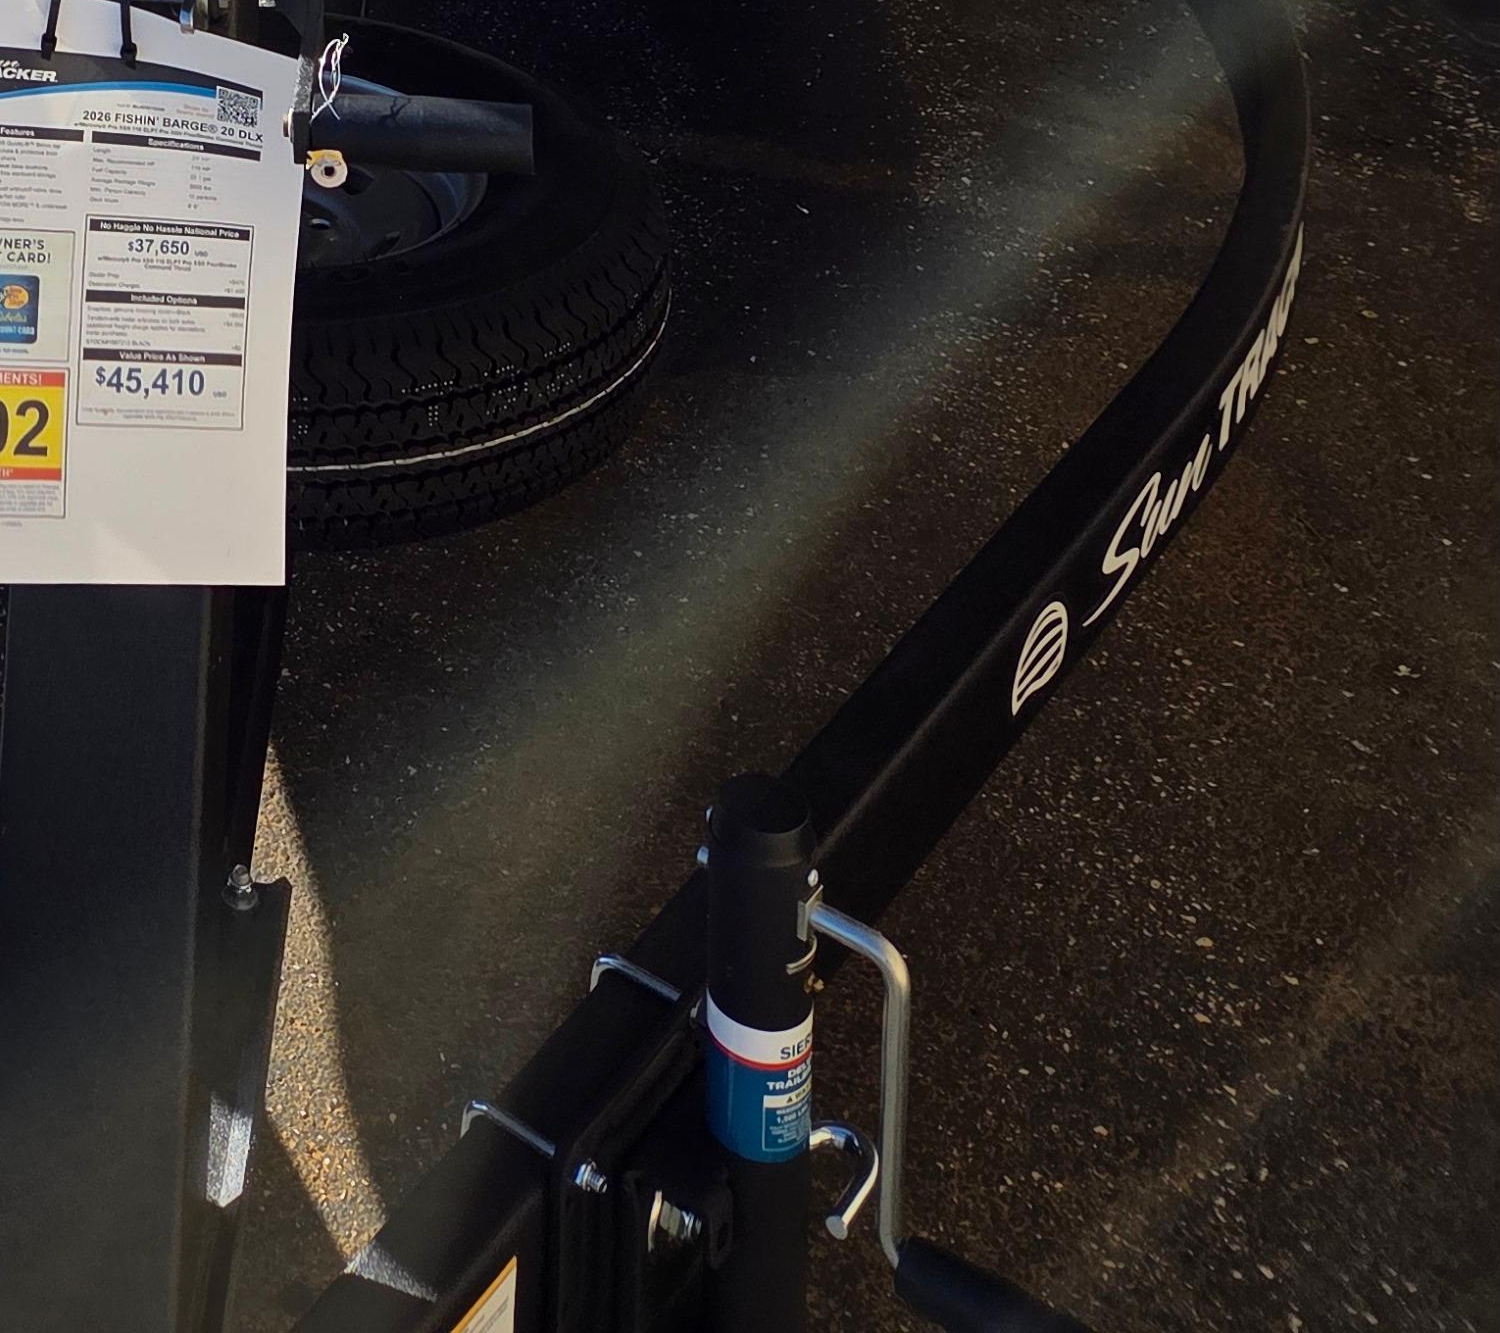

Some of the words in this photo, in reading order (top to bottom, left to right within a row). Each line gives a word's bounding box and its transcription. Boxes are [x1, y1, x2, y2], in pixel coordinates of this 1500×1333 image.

[0, 127, 35, 137] Features
[83, 110, 111, 122] 2026
[115, 112, 160, 126] FISHIN'
[221, 126, 235, 137] 20
[239, 130, 263, 142] DLX
[148, 138, 204, 151] Specifications
[100, 221, 112, 230] No
[113, 223, 141, 233] Haggle
[143, 224, 154, 232] No
[156, 225, 182, 234] Hassle
[184, 227, 217, 237] National
[219, 229, 239, 238] Price
[128, 239, 190, 256] $37,650
[7, 252, 50, 264] CARD!
[131, 293, 164, 303] Included
[166, 295, 197, 306] Options
[119, 351, 141, 360] Value
[144, 352, 163, 361] Price
[165, 353, 176, 362] As
[179, 353, 205, 363] Shown
[95, 366, 204, 399] $45,410
[1082, 434, 1213, 626] Sun
